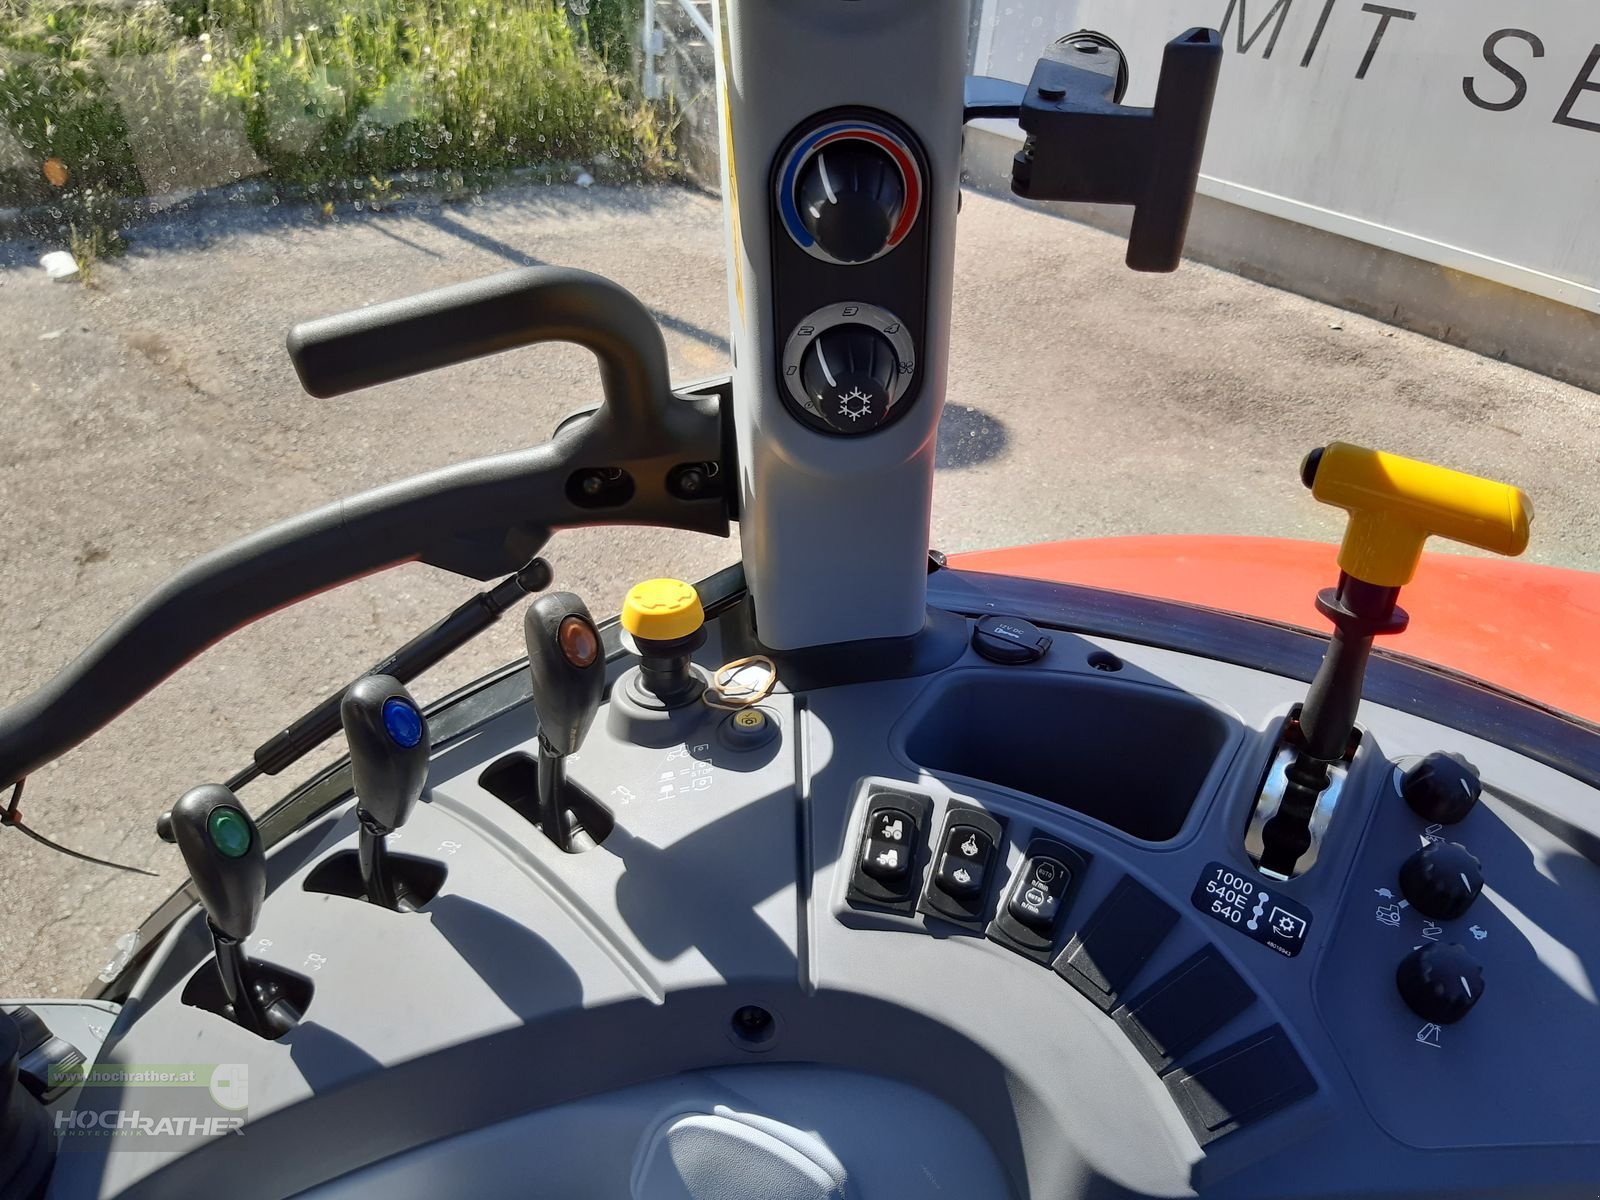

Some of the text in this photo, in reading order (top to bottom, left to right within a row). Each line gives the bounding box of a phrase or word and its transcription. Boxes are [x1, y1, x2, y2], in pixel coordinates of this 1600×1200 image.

[1220, 0, 1416, 79] MIT
[842, 306, 859, 317] 3
[798, 326, 815, 336] 2
[884, 322, 901, 335] 4
[787, 365, 798, 376] 1
[999, 623, 1013, 632] 12V
[882, 815, 889, 823] A
[1216, 868, 1253, 895] 1000
[1046, 895, 1053, 904] 2
[1205, 880, 1249, 910] 540E
[1211, 899, 1242, 923] 540
